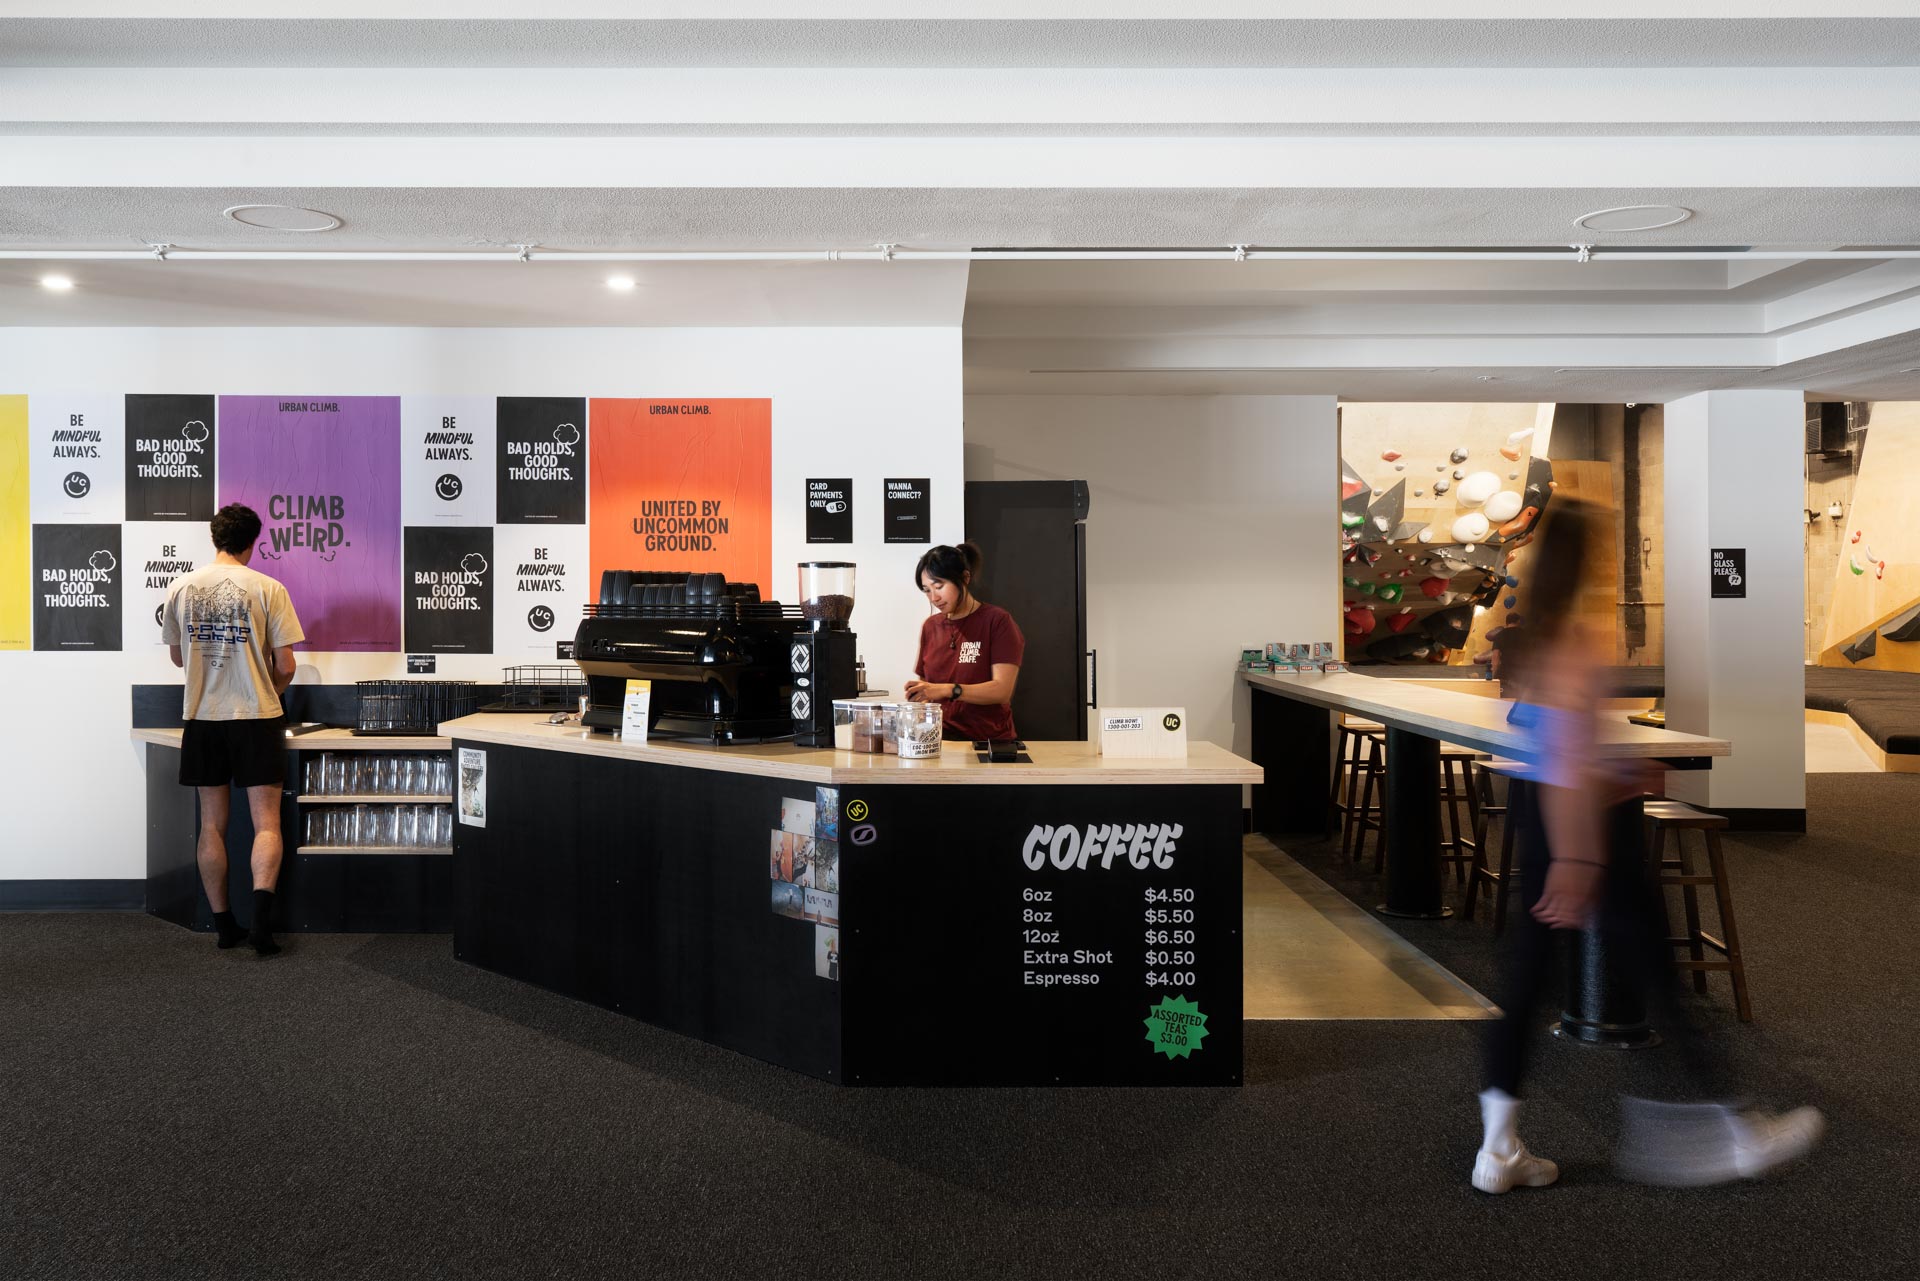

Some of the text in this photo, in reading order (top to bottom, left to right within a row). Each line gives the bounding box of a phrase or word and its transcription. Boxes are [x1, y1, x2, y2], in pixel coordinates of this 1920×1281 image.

[279, 403, 340, 412] URBAN CLIMB.
[650, 405, 711, 414] URBAN CLIMB.
[71, 415, 83, 426] BE
[443, 417, 455, 428] BE
[52, 430, 101, 442] MINDFUL
[424, 433, 473, 444] MINDFUL
[53, 446, 100, 458] ALWAYS.
[136, 439, 204, 454] BAD HOLDS,
[508, 441, 575, 458] BAD HOLDS,
[153, 452, 187, 465] GOOD
[426, 448, 472, 460] ALWAYS.
[524, 454, 558, 468] GOOD
[137, 464, 203, 478] THOUGHTS.
[508, 467, 574, 481] THOUGHTS.
[269, 495, 345, 520] CLIMB
[642, 501, 721, 517] UNITED BY
[634, 518, 728, 534] UNCOMMON
[269, 521, 351, 553] WEIRD.
[645, 535, 716, 551] GROUND.
[163, 545, 176, 557] BE
[535, 548, 547, 560] BE
[144, 560, 195, 573] MINDFUL
[517, 564, 565, 575] MINDFUL
[43, 568, 112, 584] BAD HOLDS,
[415, 571, 483, 587] BAD HOLDS,
[59, 581, 95, 595] GOOD
[431, 584, 466, 598] GOOD
[518, 580, 564, 591] ALWAYS.
[44, 594, 110, 608] THOUGHTS.
[416, 596, 481, 611] THOUGHTS.
[961, 641, 981, 649] URBAN
[1166, 717, 1178, 727] UC
[850, 804, 864, 816] UC
[1023, 823, 1183, 870] COFFEE
[1023, 887, 1194, 904] 6oz $4.50
[1023, 908, 1194, 924] 8oz $5.50
[1023, 929, 1194, 945] 12oz $6.50
[1024, 950, 1194, 966] Extra Shot $0.50
[1024, 971, 1195, 987] Espresso $4.00
[1153, 1010, 1202, 1026] ASSORTED
[1165, 1021, 1188, 1035] TEAS
[1160, 1032, 1188, 1046] $3.00
